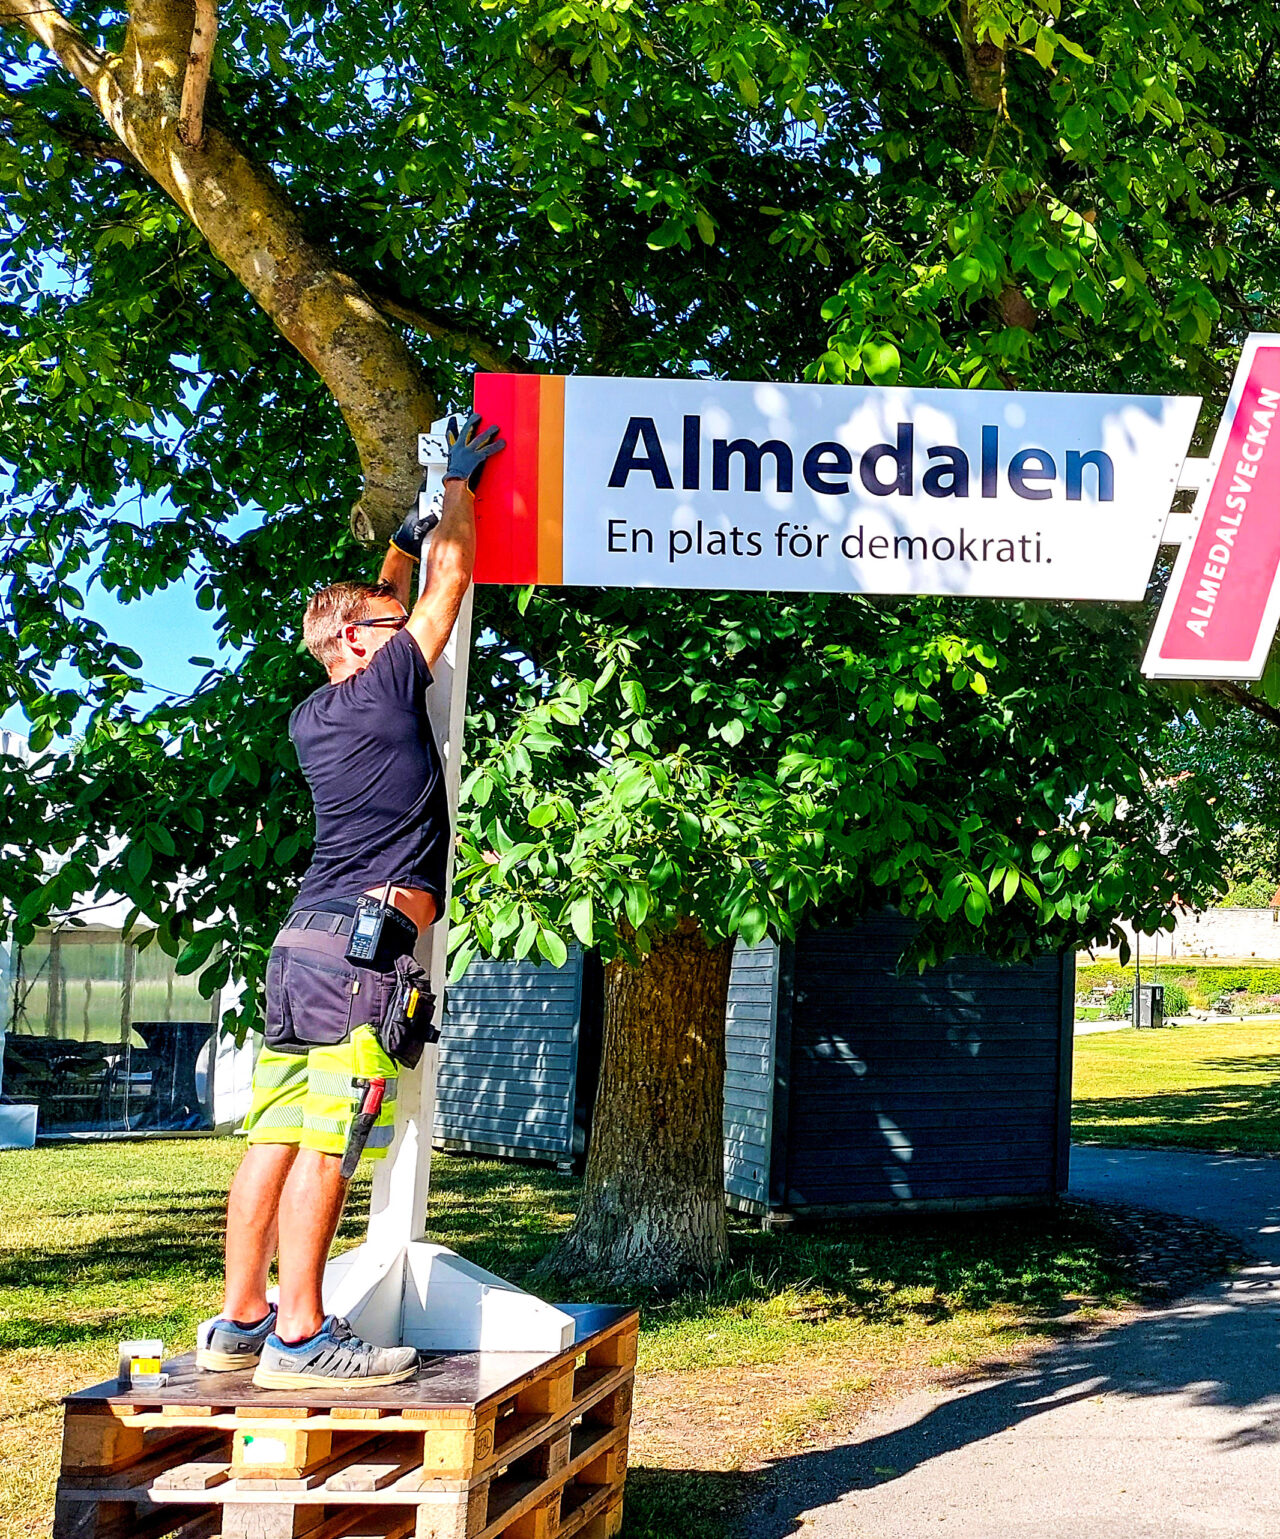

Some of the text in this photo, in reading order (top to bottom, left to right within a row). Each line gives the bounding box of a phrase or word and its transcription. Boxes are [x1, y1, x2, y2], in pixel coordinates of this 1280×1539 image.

[606, 414, 1115, 503] Almedalen
[607, 518, 1054, 565] En plats för demokrati.
